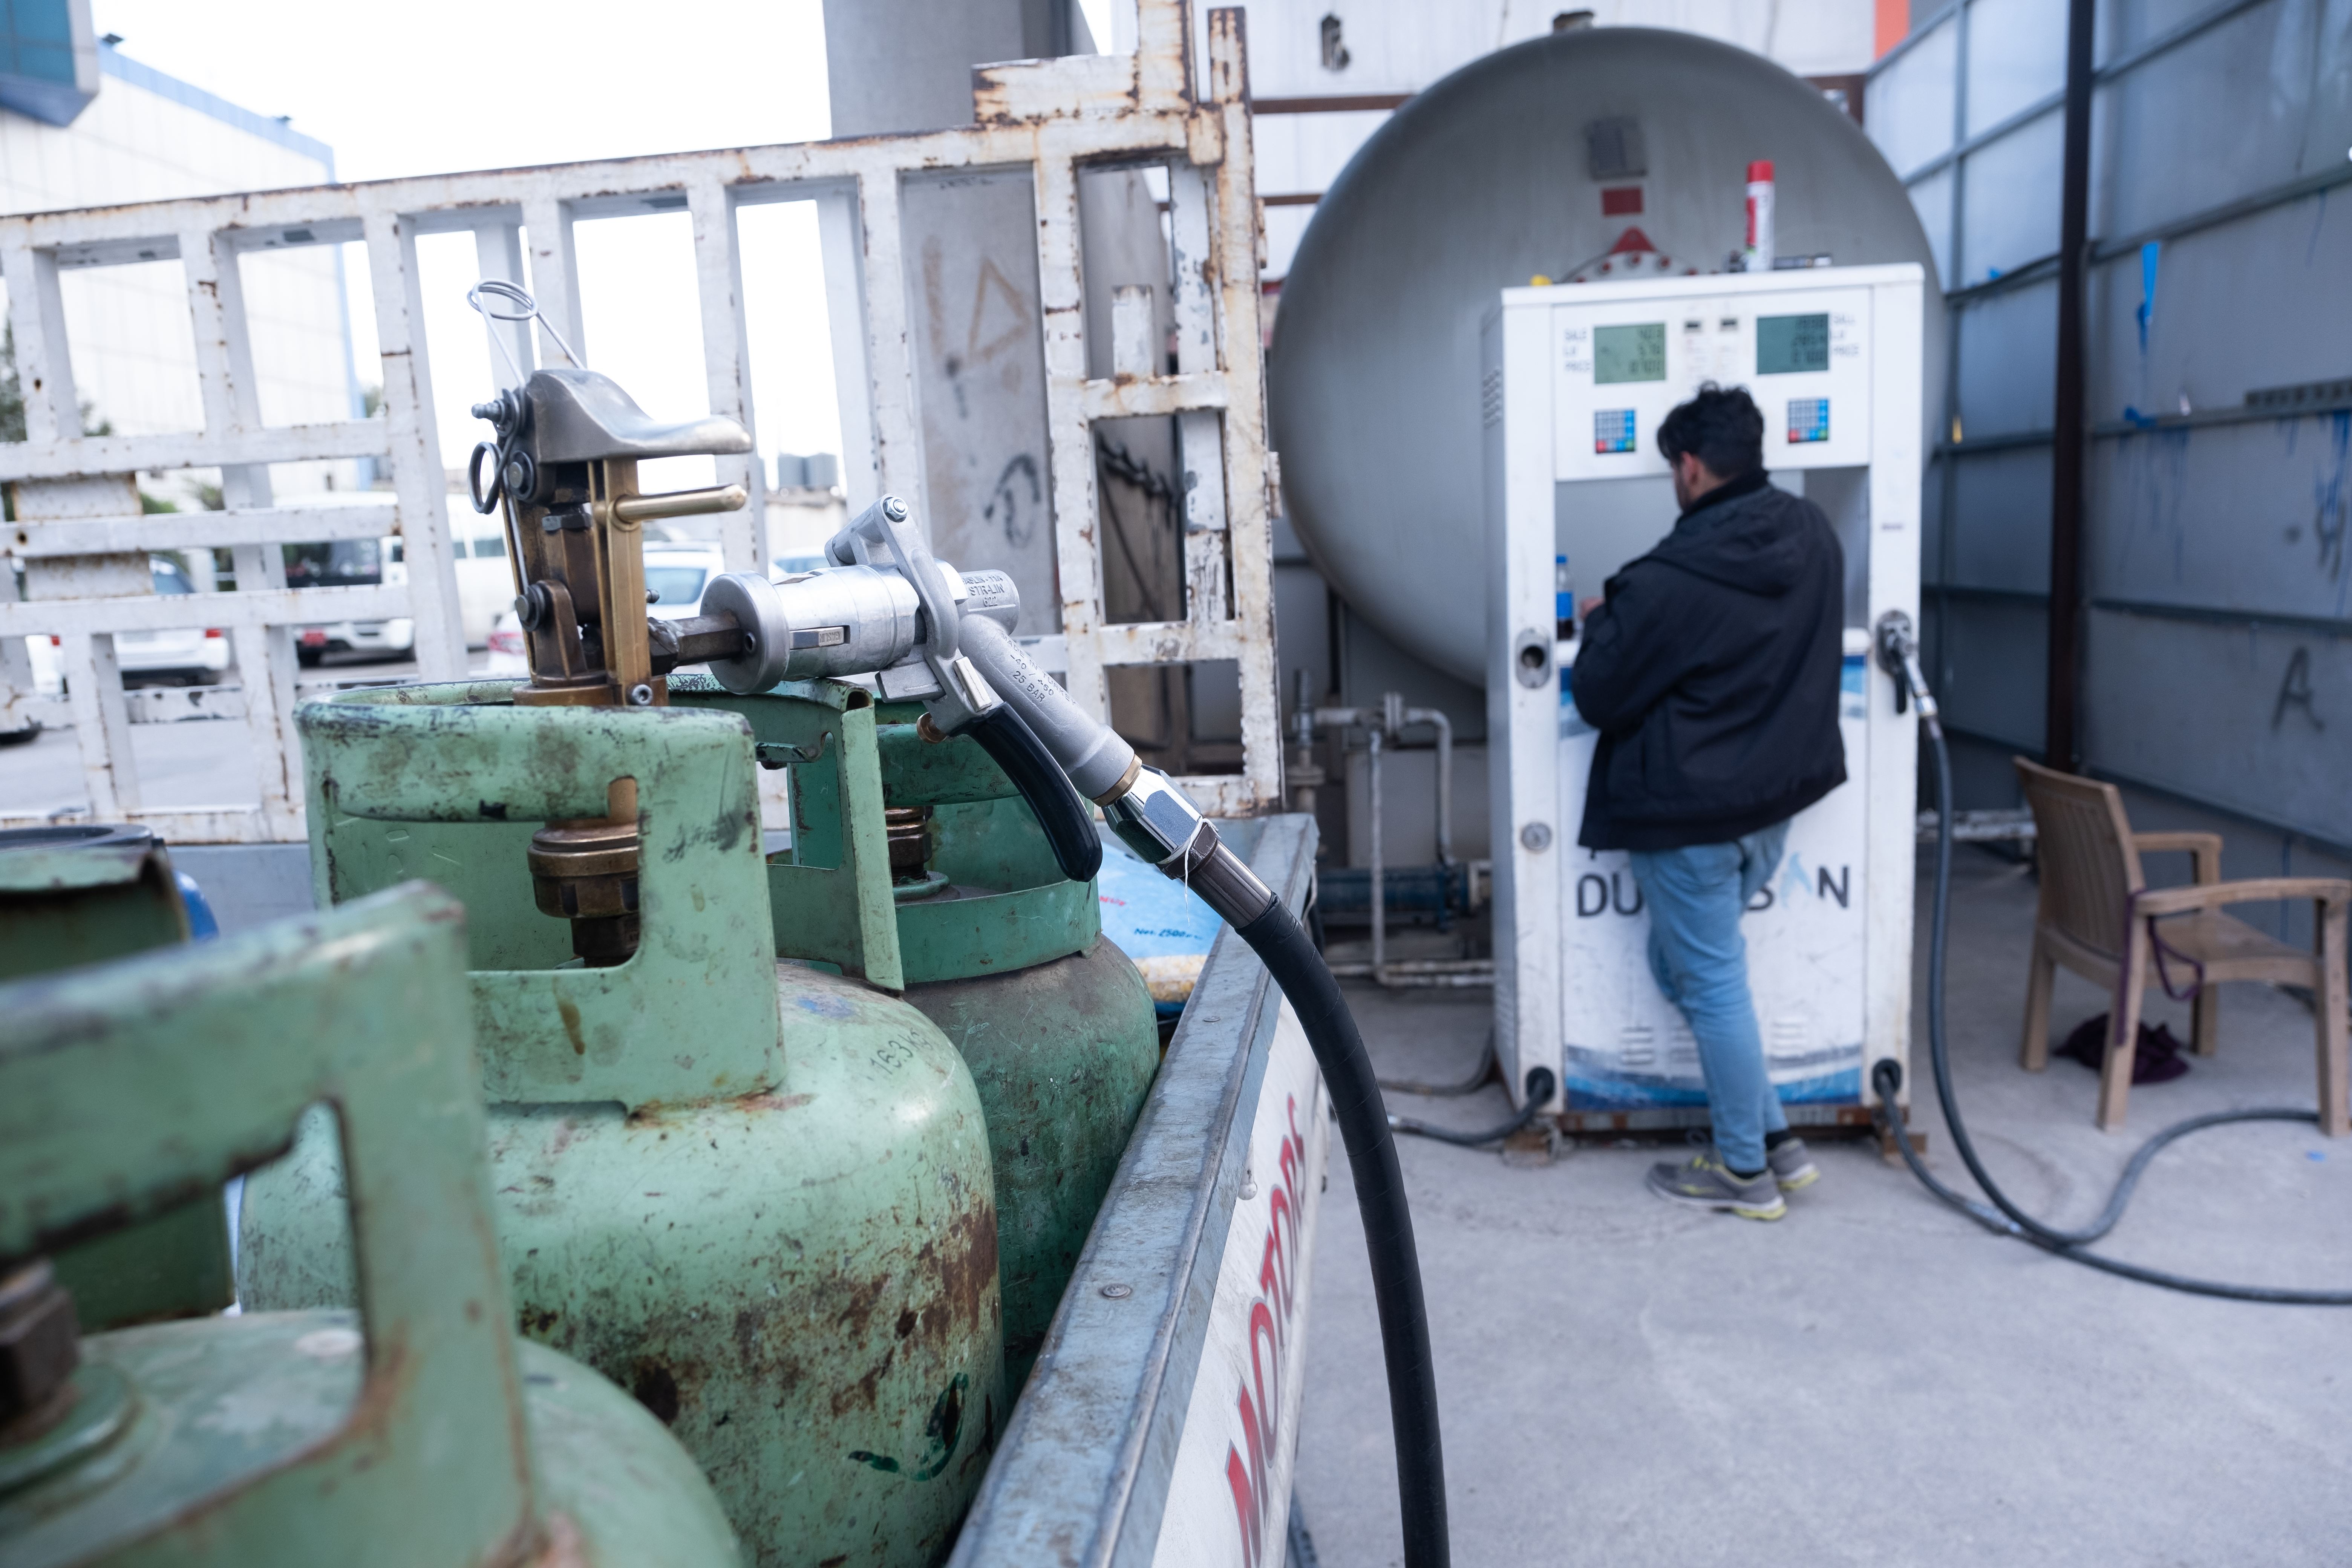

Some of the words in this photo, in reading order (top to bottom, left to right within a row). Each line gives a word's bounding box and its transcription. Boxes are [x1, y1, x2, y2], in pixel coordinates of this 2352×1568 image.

[969, 584, 1004, 596] STR-LIN
[983, 596, 998, 606] 622
[1001, 633, 1024, 658] MADE
[1029, 659, 1038, 670] IN
[1043, 673, 1076, 706] TURKEY
[1012, 671, 1026, 683] 25
[1026, 683, 1045, 703] BAR
[1225, 1092, 1305, 1568] MOTORS
